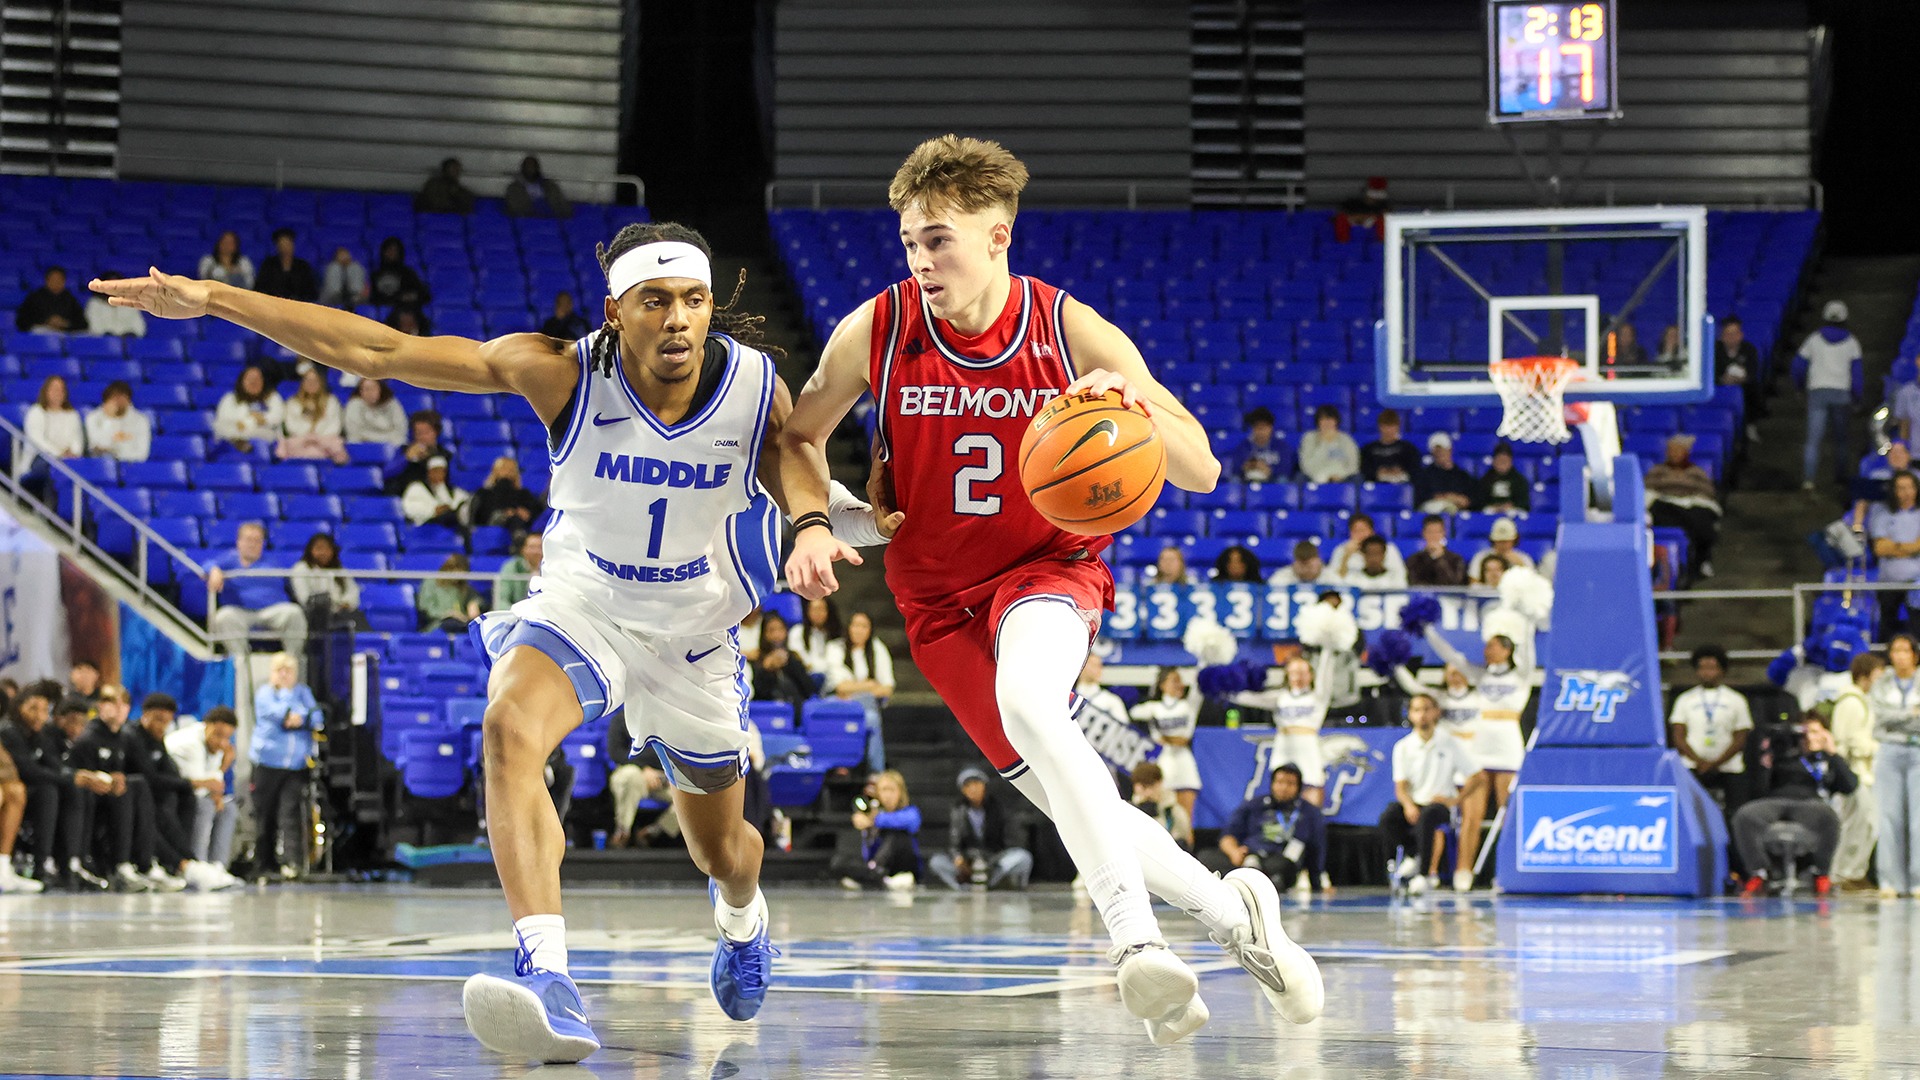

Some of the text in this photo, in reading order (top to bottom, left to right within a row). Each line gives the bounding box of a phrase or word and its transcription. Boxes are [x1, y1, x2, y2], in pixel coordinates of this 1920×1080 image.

[1524, 4, 1603, 43] 2:13
[1538, 44, 1595, 105] 17
[900, 386, 1060, 418] BELMONT
[594, 452, 732, 489] MIDDLE
[952, 433, 1003, 516] 2
[647, 498, 668, 559] 1
[586, 549, 711, 583] TENNESSEE
[1555, 675, 1629, 723] MT
[1524, 816, 1668, 851] Ascend
